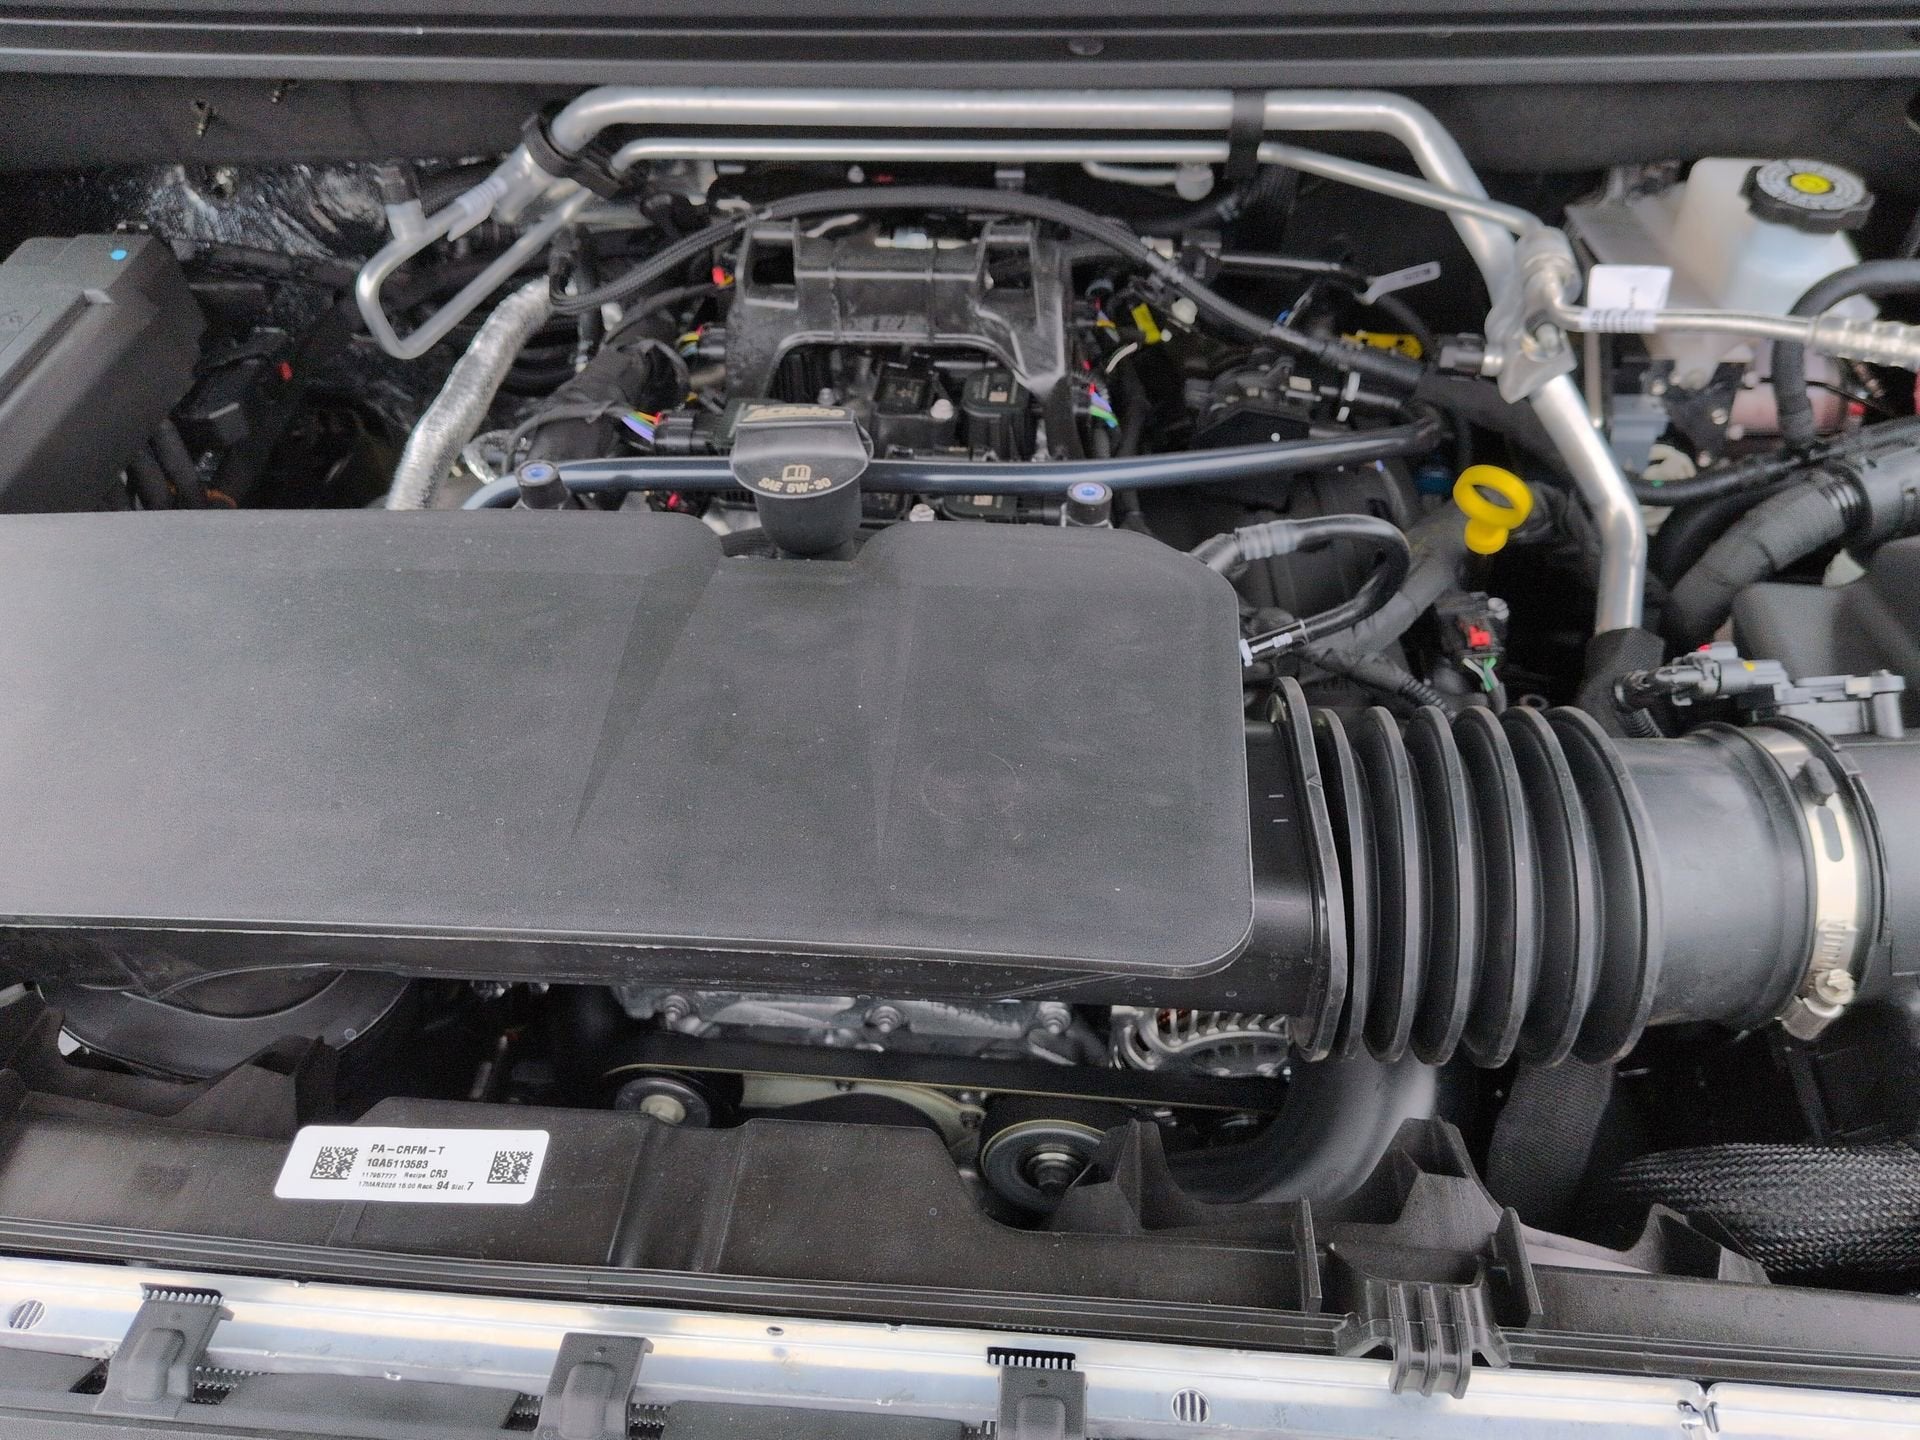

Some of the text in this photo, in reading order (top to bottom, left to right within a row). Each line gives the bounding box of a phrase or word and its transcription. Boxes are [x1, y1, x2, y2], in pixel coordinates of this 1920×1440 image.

[758, 477, 784, 492] SAE
[430, 1169, 448, 1178] CR3
[436, 1181, 450, 1190] 94
[467, 1181, 474, 1191] 7
